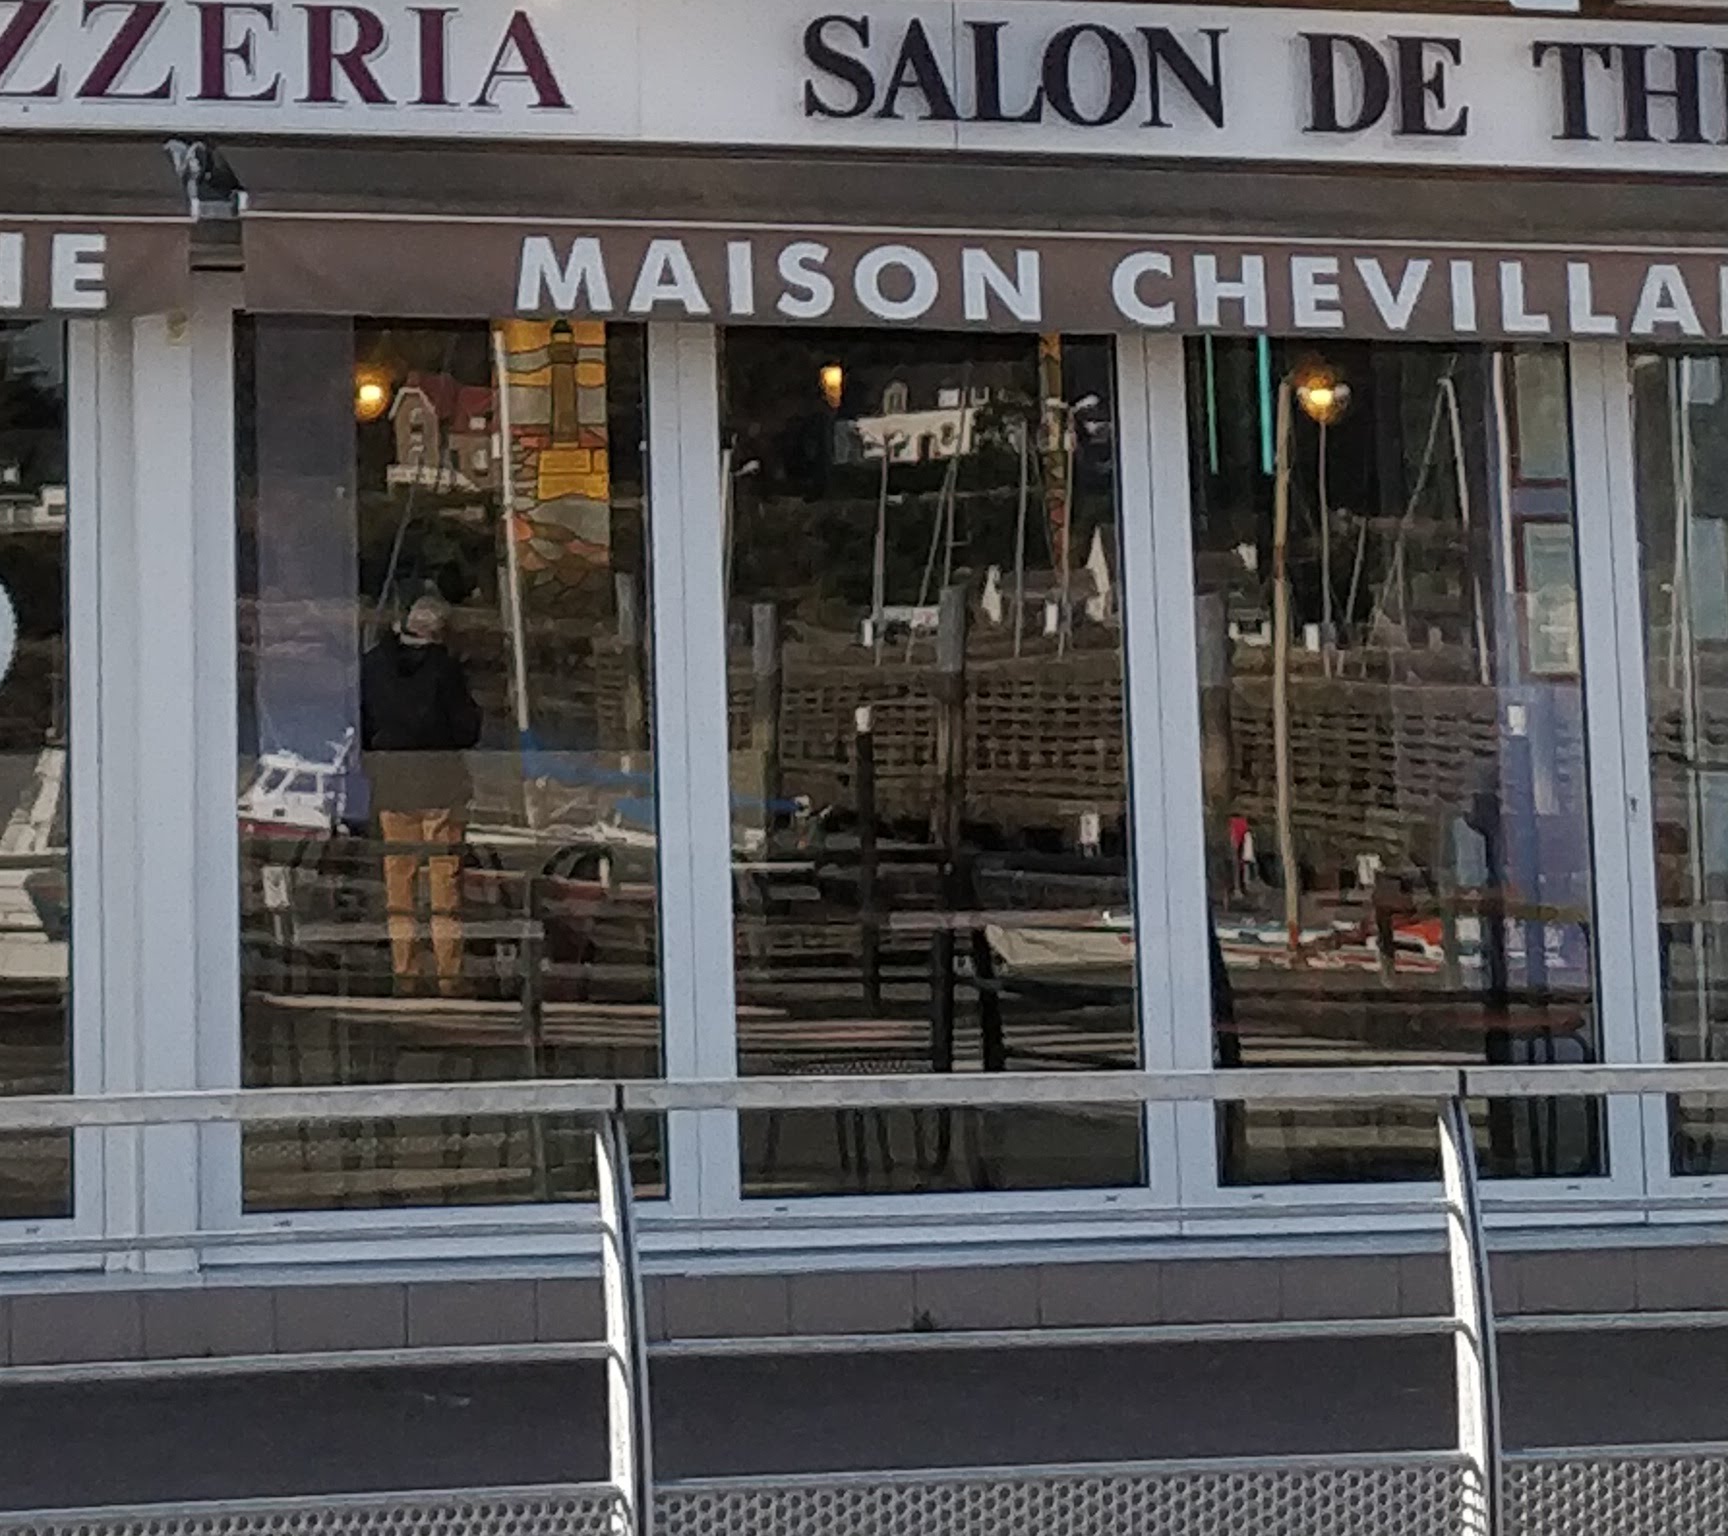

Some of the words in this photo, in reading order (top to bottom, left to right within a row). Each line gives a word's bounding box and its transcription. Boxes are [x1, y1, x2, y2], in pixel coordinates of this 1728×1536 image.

[802, 15, 1228, 129] SALON
[1299, 31, 1469, 137] DE
[1532, 40, 1728, 145] TH
[516, 235, 1043, 323] MAISON
